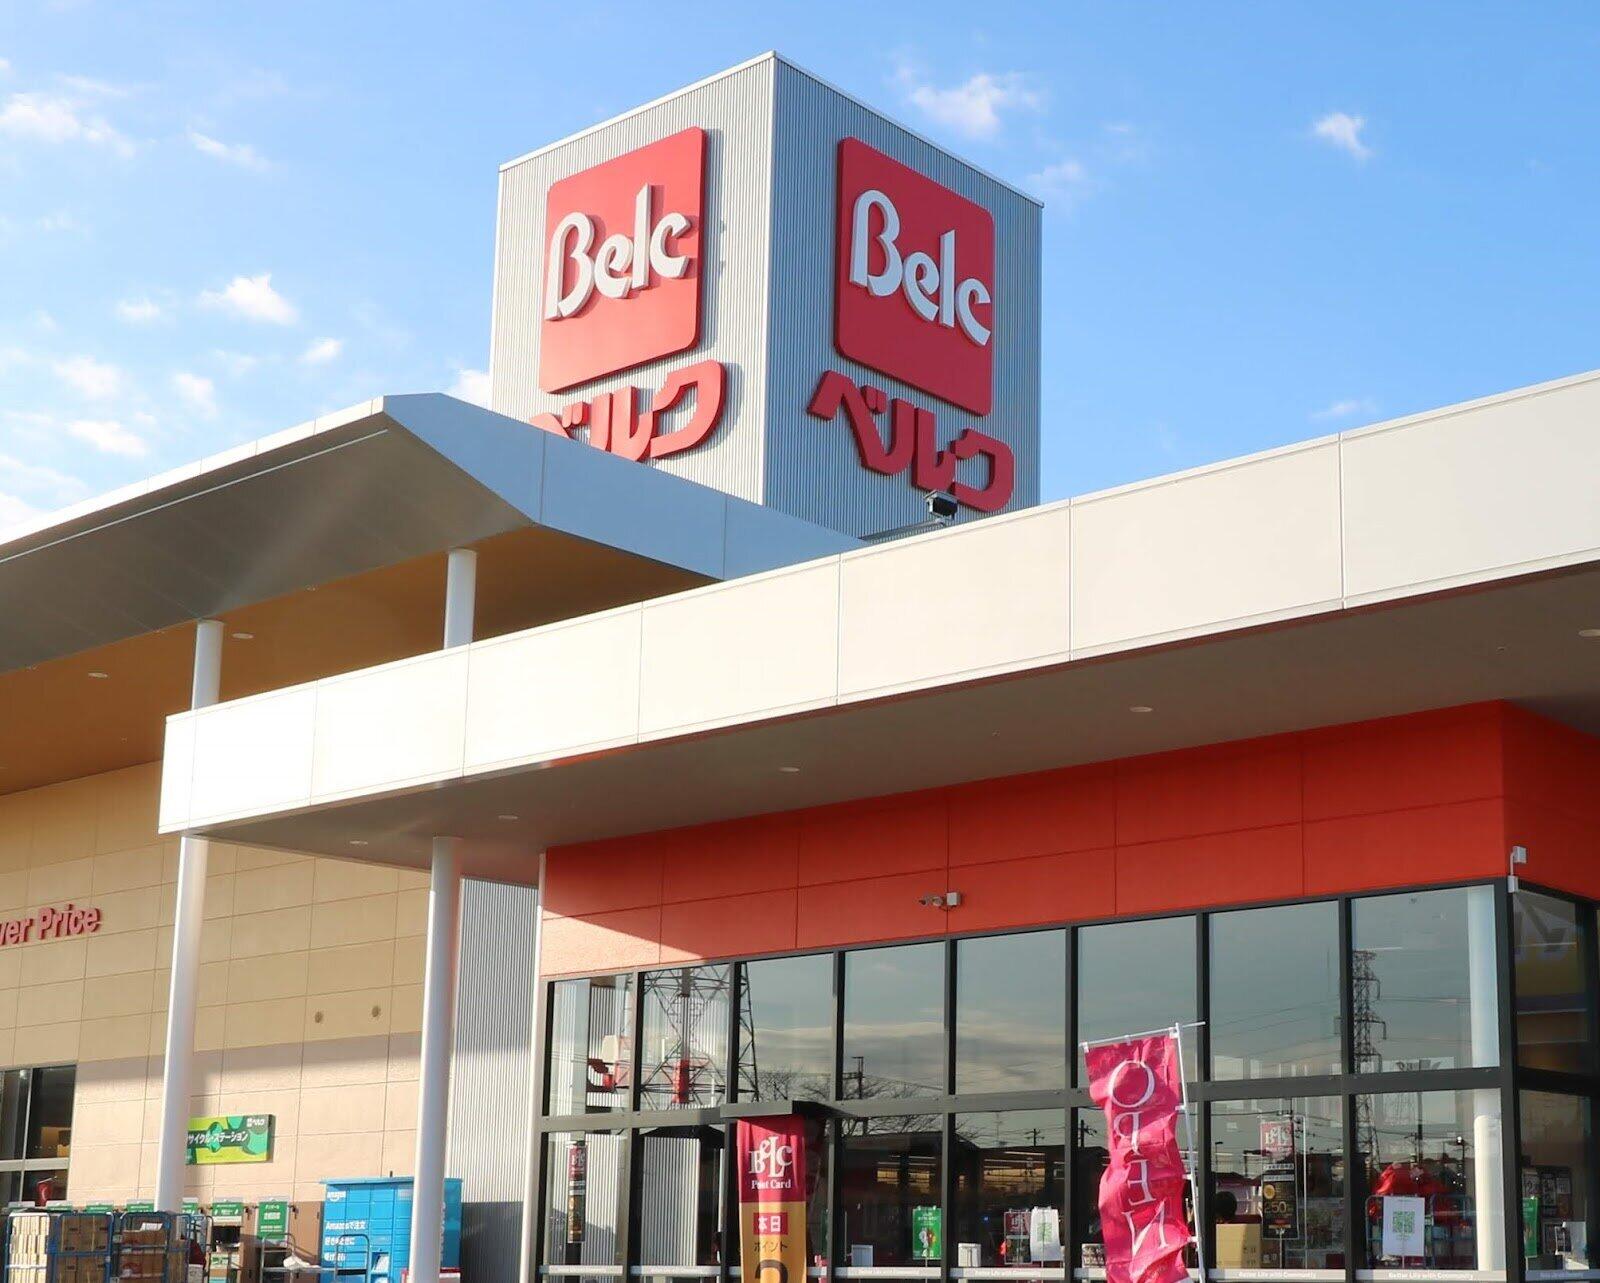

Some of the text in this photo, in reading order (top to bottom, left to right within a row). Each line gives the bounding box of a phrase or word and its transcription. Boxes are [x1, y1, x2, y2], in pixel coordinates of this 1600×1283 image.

[545, 184, 693, 320] Belc
[849, 190, 992, 347] Belc
[807, 370, 1016, 513] ベルク
[39, 904, 103, 939] Price
[187, 1131, 249, 1145] サイクル・ステーション
[769, 1179, 792, 1189] Card
[758, 1215, 781, 1233] 本日
[753, 1241, 788, 1253] ポイント
